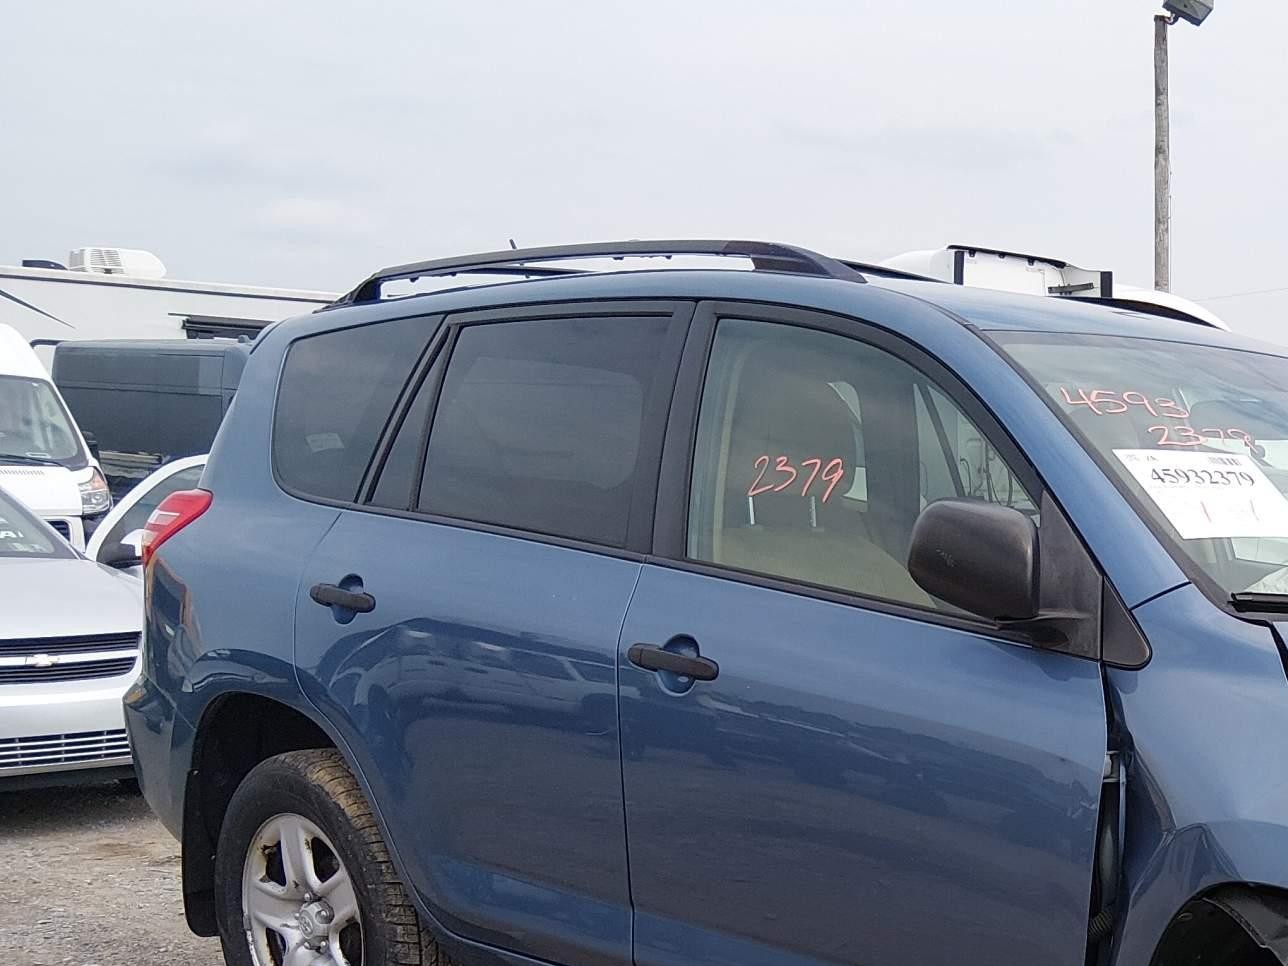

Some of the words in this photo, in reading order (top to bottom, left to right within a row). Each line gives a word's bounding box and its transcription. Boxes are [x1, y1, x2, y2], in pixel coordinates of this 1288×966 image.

[1060, 386, 1190, 418] 4593
[1147, 426, 1259, 454] 2379
[747, 455, 844, 503] 2379
[1151, 468, 1255, 486] 45932379
